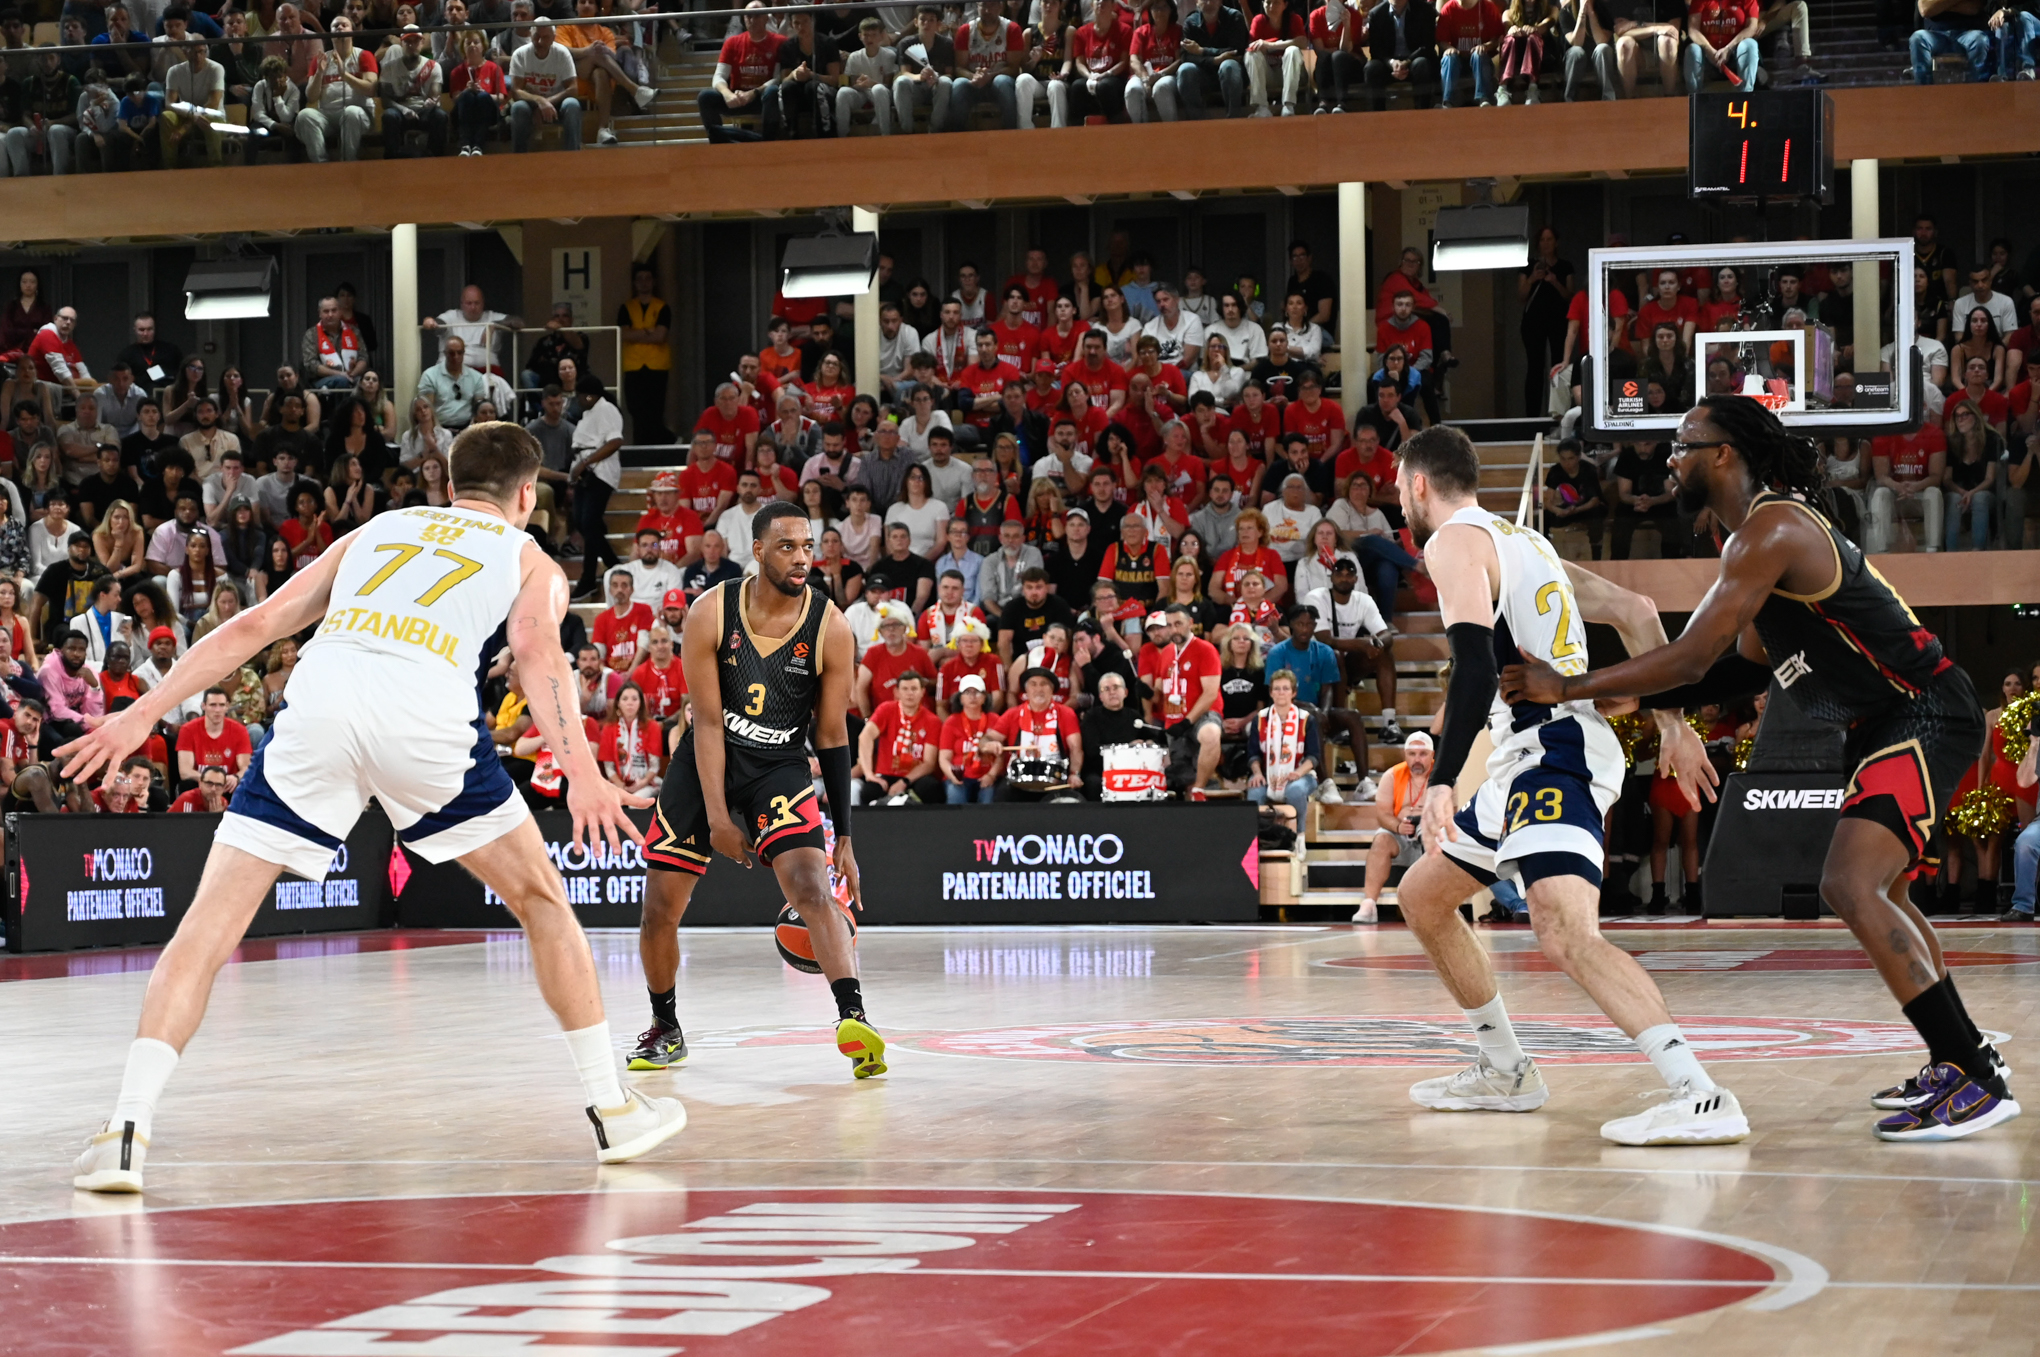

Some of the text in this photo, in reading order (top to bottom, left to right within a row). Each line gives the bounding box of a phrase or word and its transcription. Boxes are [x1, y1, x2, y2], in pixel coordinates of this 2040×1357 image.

[524, 76, 557, 88] PLAY
[563, 251, 590, 290] H
[1603, 420, 1635, 428] SPALDING
[355, 543, 484, 607] 77
[1535, 580, 1583, 659] 2
[744, 683, 766, 716] 3
[770, 795, 789, 829] 3
[1508, 787, 1564, 833] 23
[275, 879, 360, 910] PARTENAIRE OFFICIEL
[942, 870, 1156, 900] PARTENAIRE OFFICIEL
[67, 887, 165, 921] PARTENAIRE OFFICIEL
[223, 1203, 1082, 1357] FEDCOM
